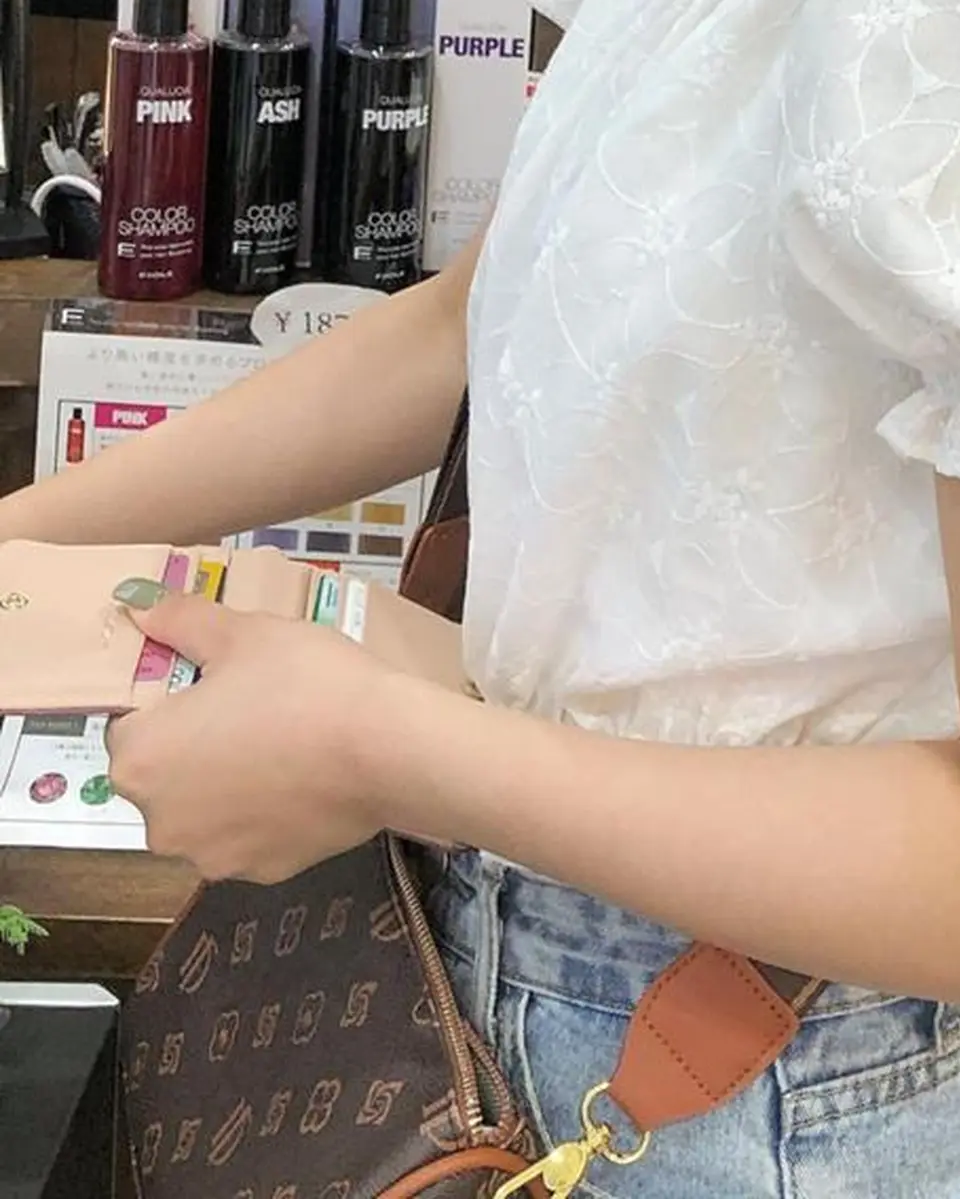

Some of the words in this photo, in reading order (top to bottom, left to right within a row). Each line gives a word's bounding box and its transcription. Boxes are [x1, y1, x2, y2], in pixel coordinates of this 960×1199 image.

[438, 34, 525, 58] PURPLE
[136, 99, 194, 124] PINK
[257, 98, 301, 124] ASH
[362, 104, 429, 132] PURPLE
[131, 205, 188, 223] COLOR
